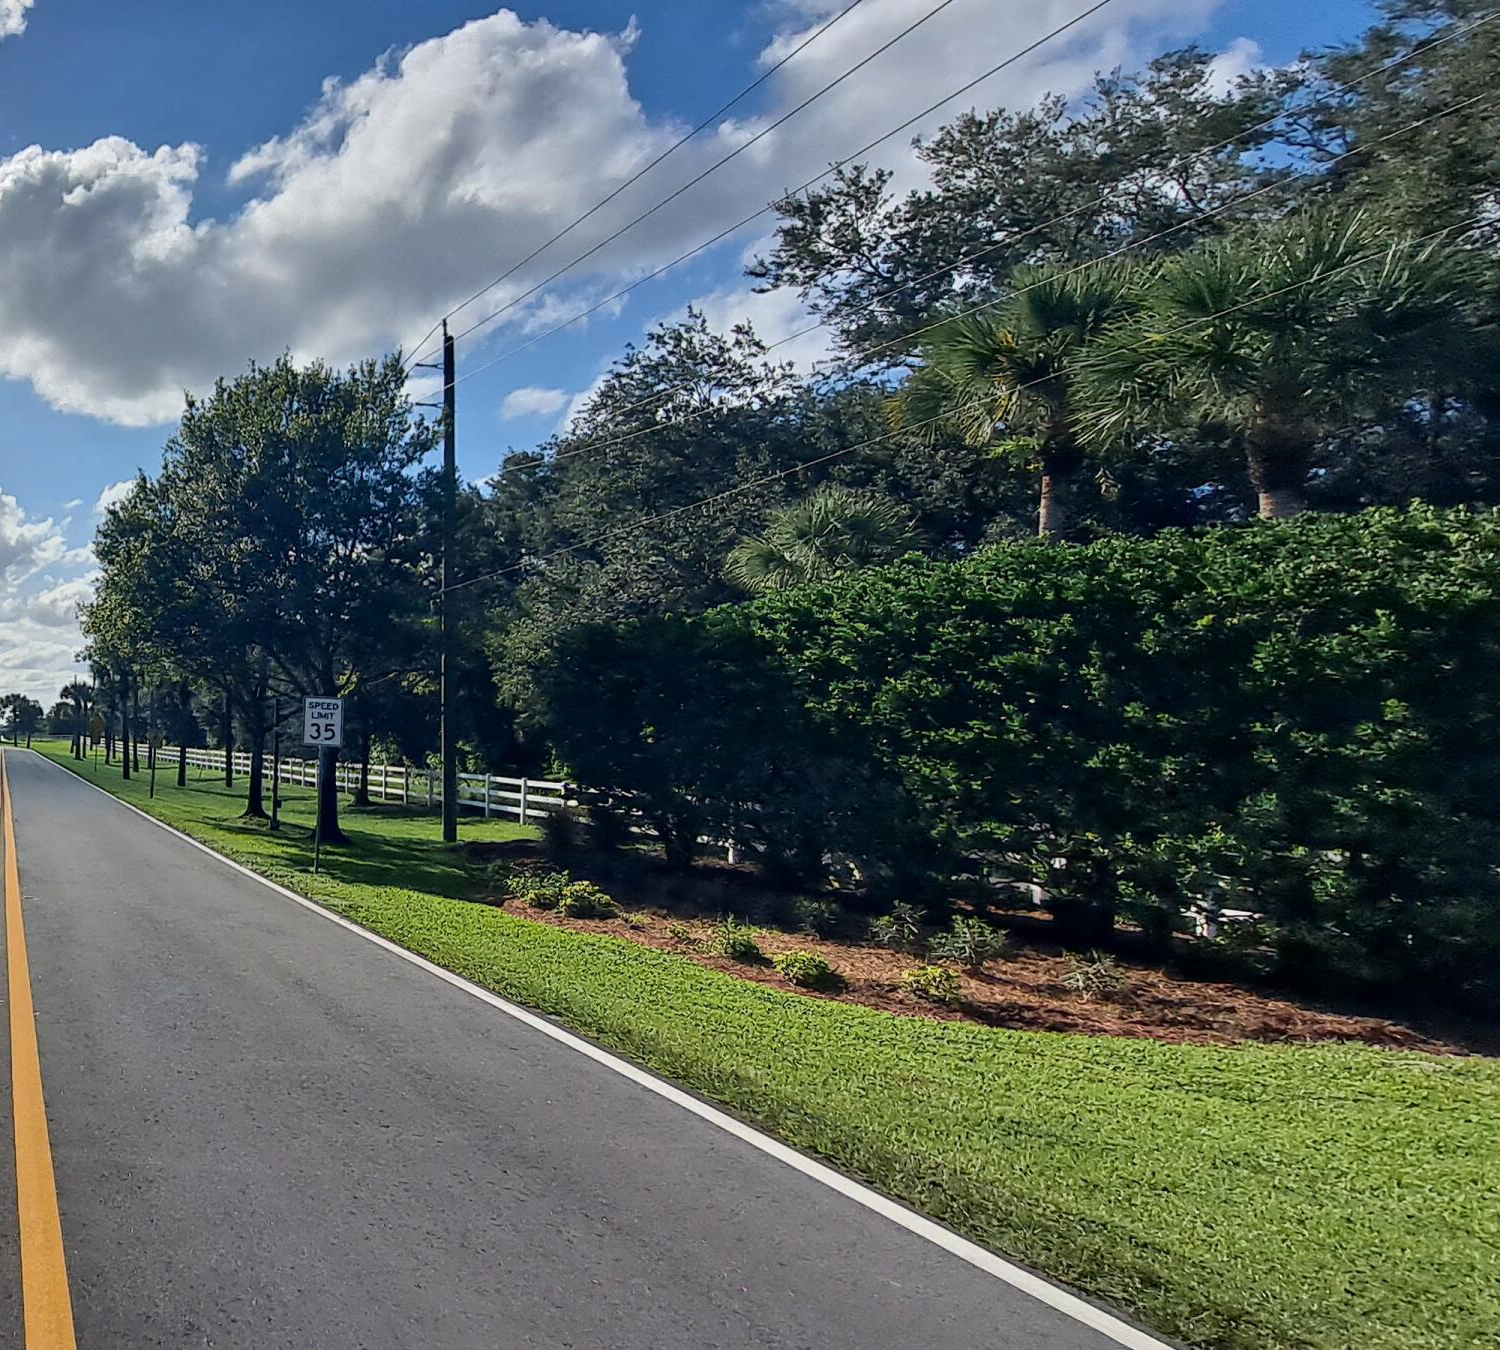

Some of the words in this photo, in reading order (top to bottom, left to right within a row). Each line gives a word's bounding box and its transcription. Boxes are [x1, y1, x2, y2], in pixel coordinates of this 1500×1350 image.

[308, 701, 339, 710] SPEED
[311, 711, 335, 720] LIMIT
[310, 722, 335, 740] 35
